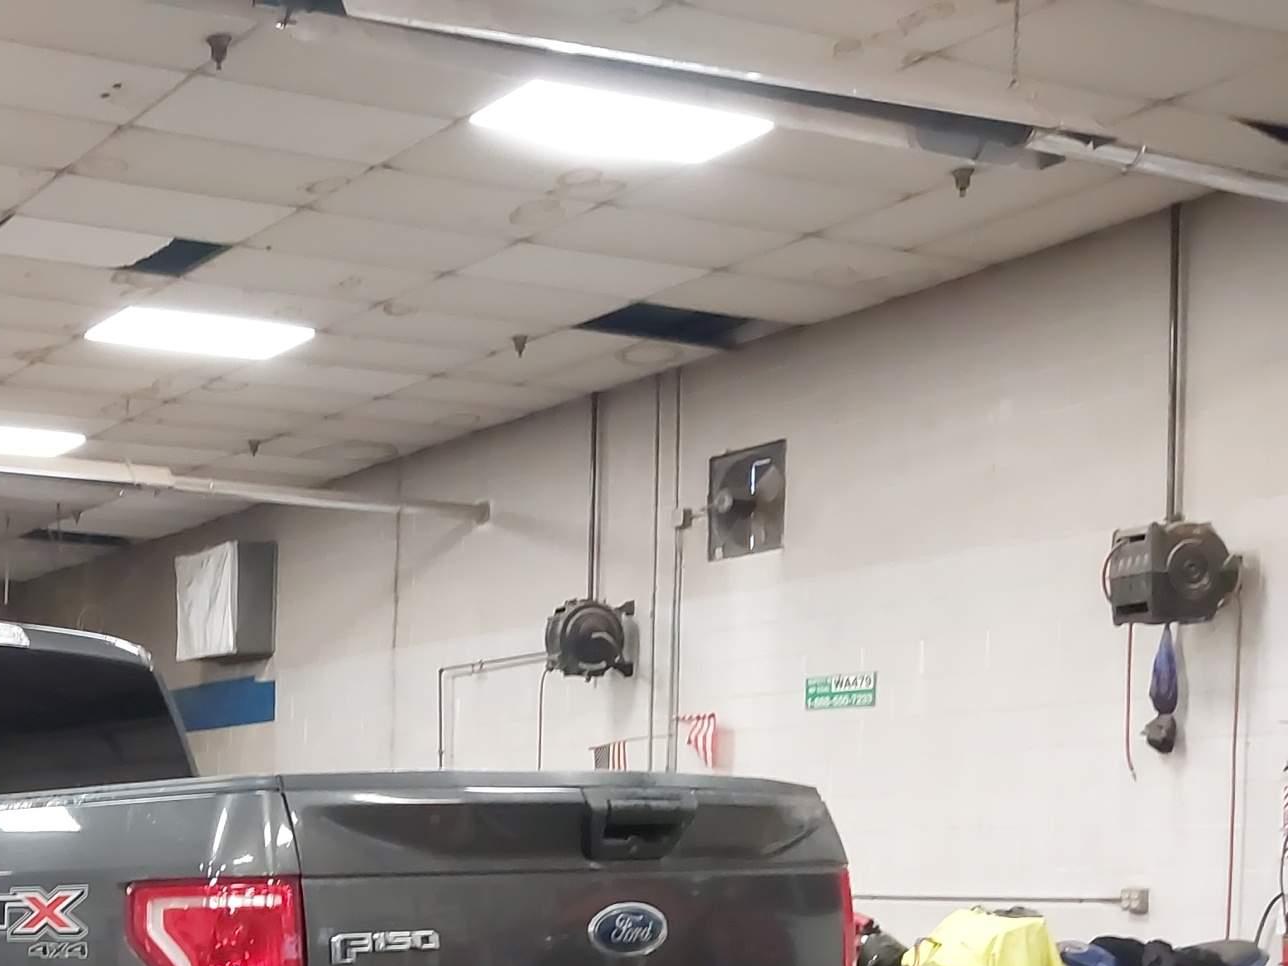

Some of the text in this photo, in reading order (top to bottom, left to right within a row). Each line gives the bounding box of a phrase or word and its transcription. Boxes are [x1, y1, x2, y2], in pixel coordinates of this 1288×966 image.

[834, 674, 872, 689] WA479
[611, 913, 654, 943] Ford
[330, 929, 440, 965] F150
